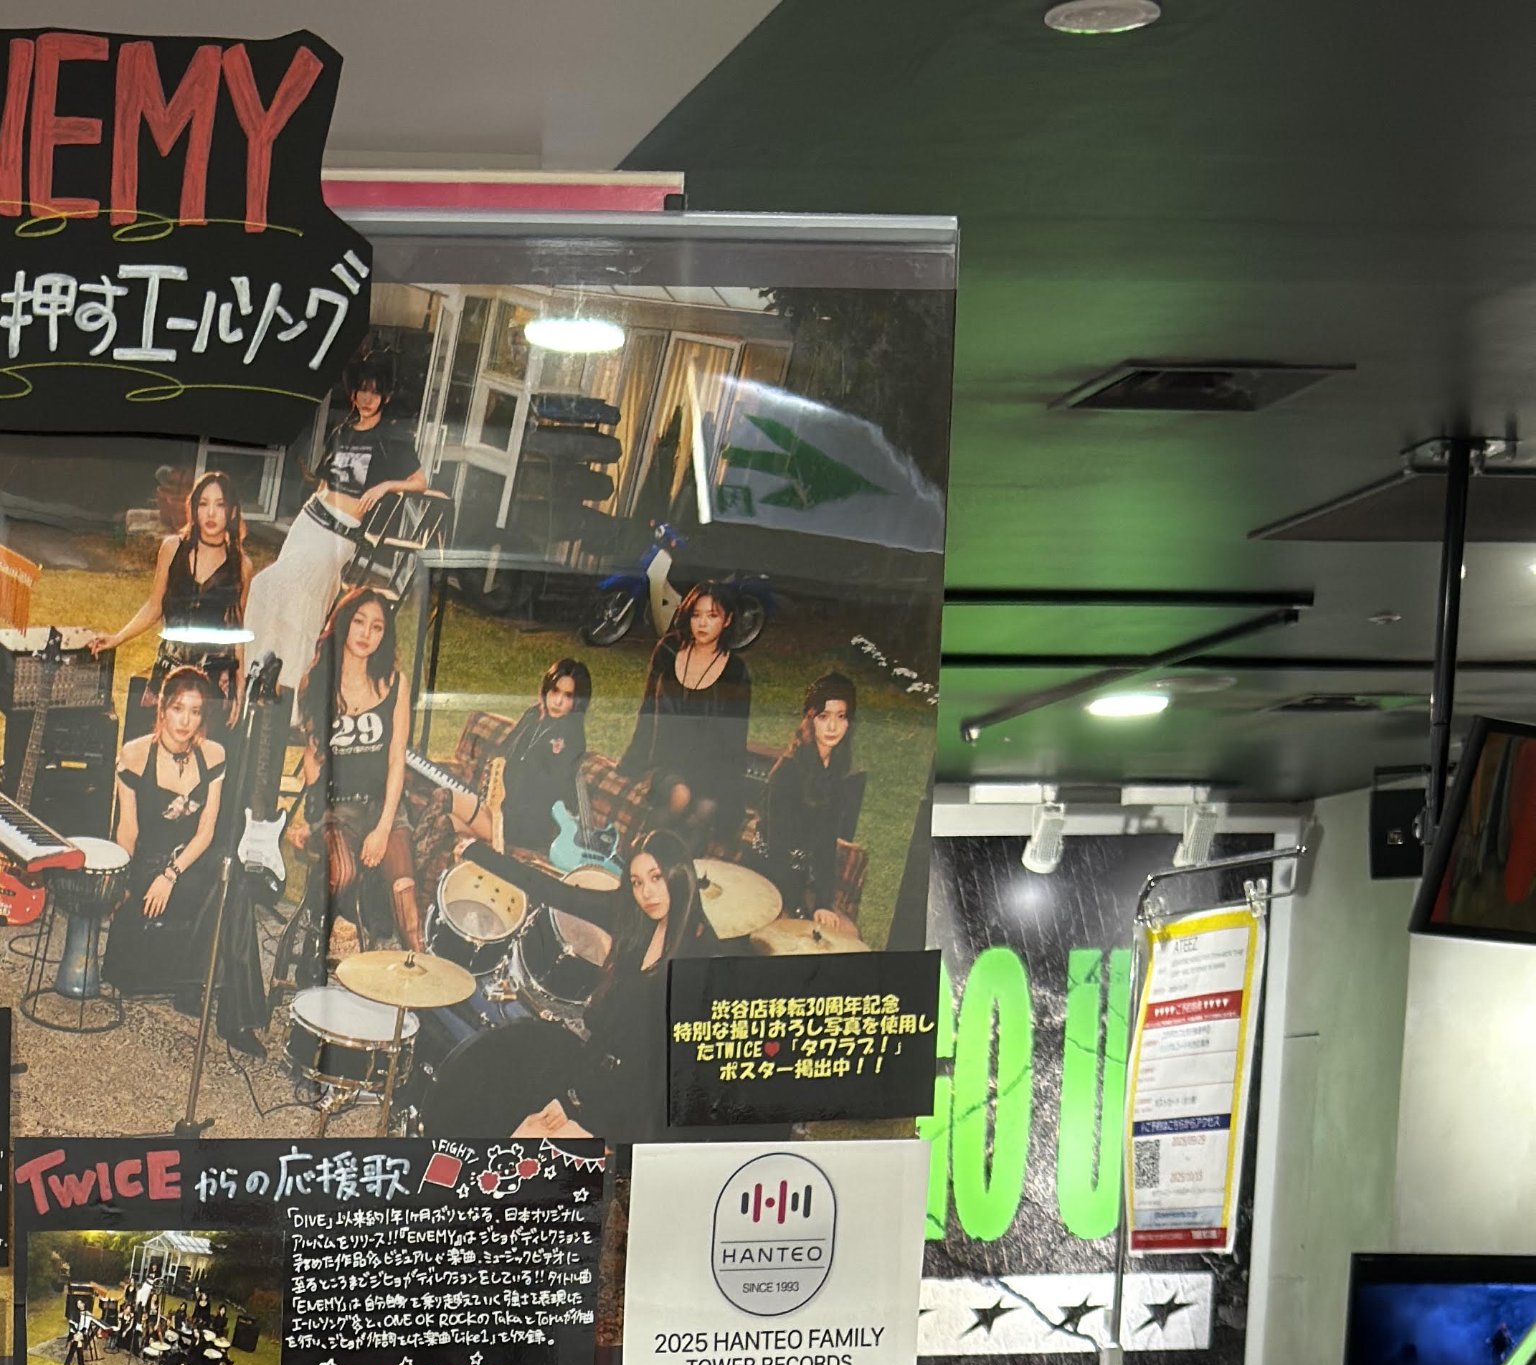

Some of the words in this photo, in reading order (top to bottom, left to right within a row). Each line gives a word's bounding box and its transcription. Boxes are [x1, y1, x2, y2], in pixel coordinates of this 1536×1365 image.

[330, 713, 384, 747] 29
[712, 996, 899, 1019] 渋谷店移転30周年記念
[674, 1015, 934, 1043] 特別な撮りおろし写真を使用し
[15, 1150, 182, 1215] TWICE
[195, 1145, 411, 1204] からの応援歌
[722, 1247, 822, 1265] HANTEO
[742, 1282, 773, 1293] SINCE
[776, 1281, 799, 1292] 1993
[655, 1333, 707, 1353] 2025
[714, 1330, 802, 1352] HANTEO
[809, 1328, 884, 1347] FAMILY
